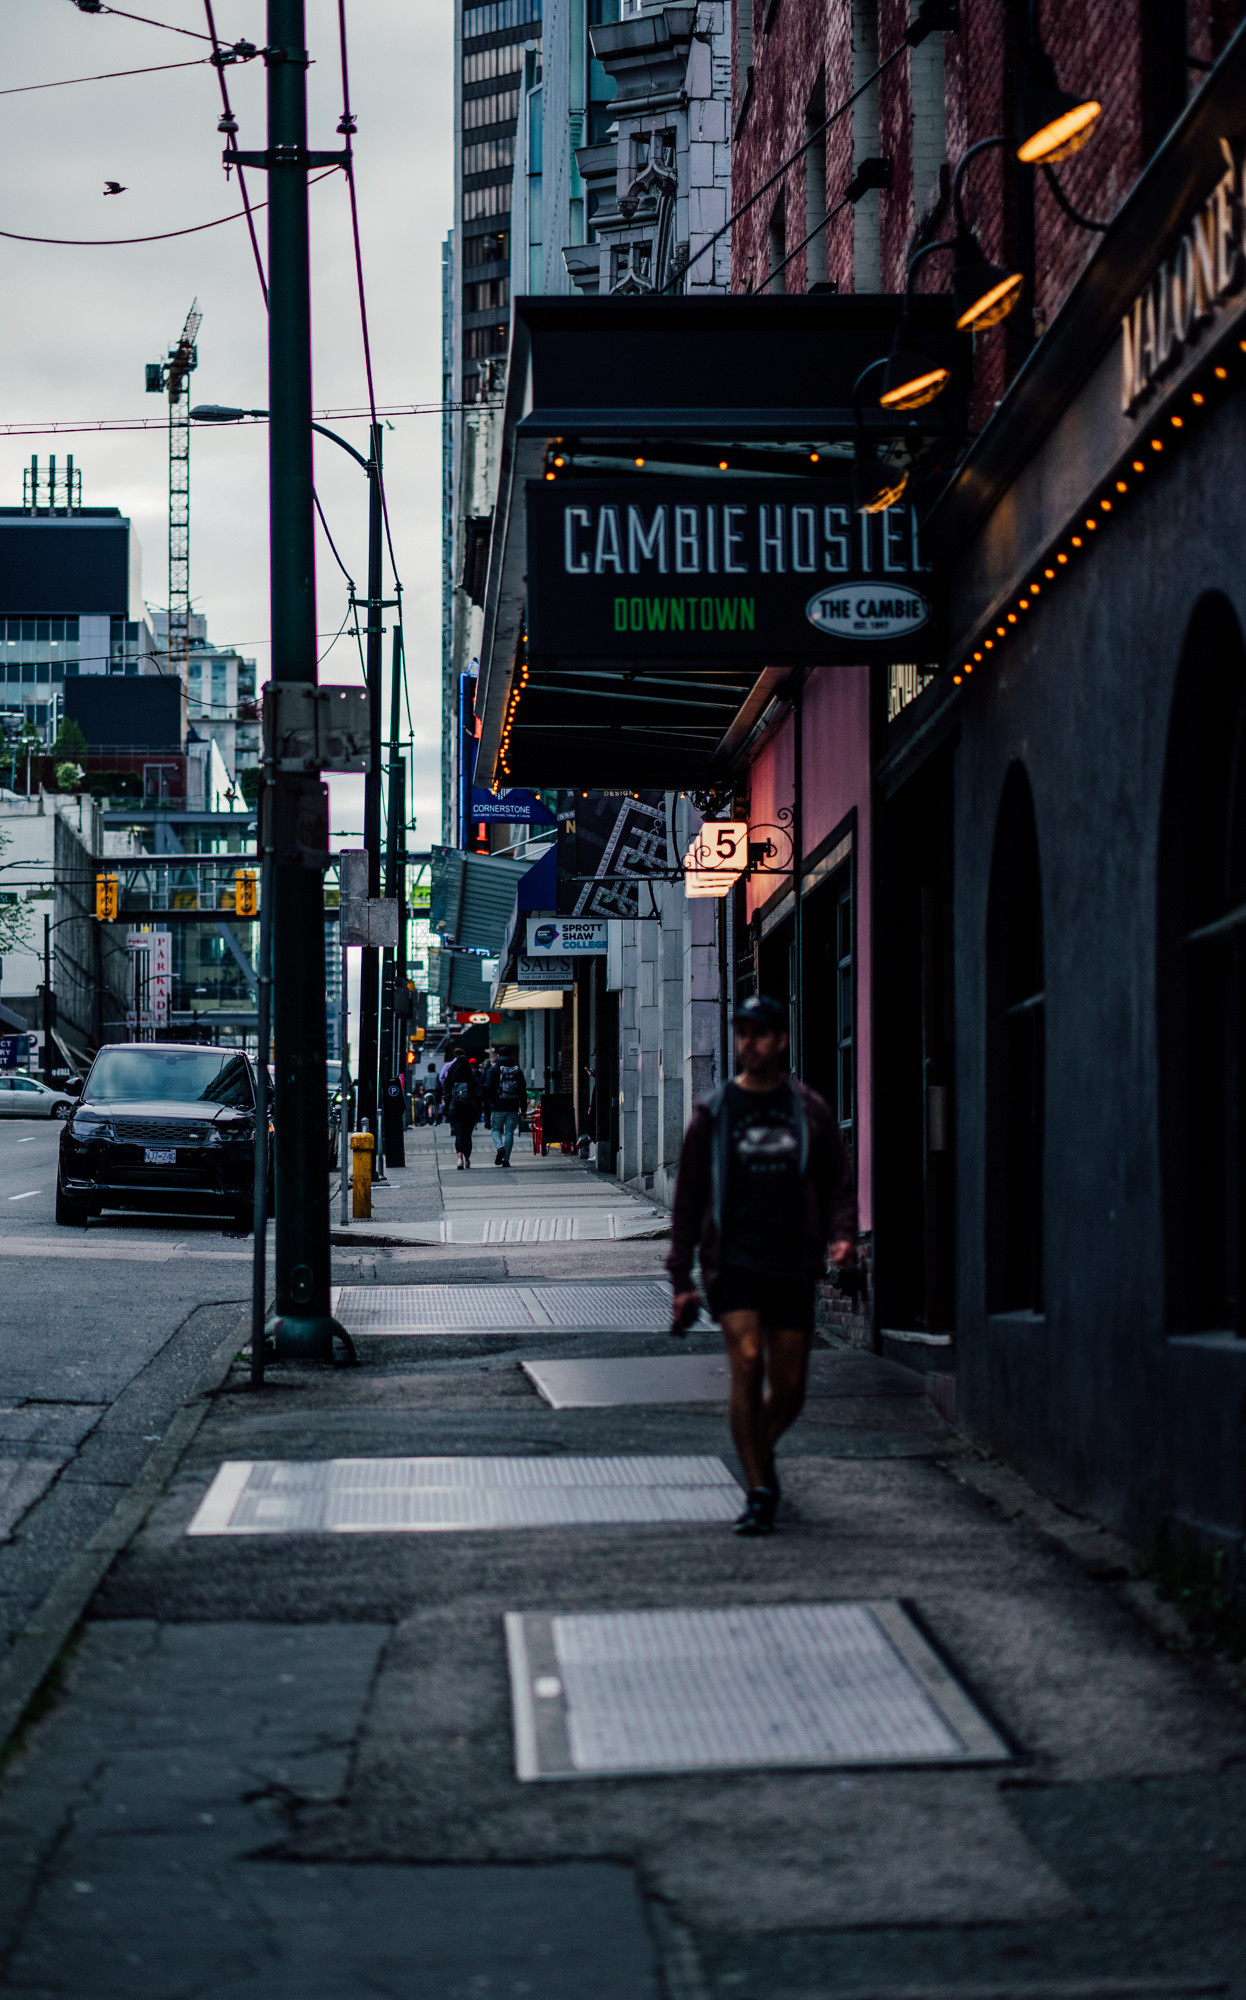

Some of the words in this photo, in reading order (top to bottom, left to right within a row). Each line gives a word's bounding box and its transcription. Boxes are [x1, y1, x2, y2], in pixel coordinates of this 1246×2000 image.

[564, 503, 749, 575] CAMBIE
[758, 503, 932, 573] HOSTEL
[613, 597, 755, 632] DOWNTOWN
[819, 598, 851, 619] THE
[855, 598, 920, 619] CAMBIE
[473, 804, 531, 814] CORNERSTONE
[716, 828, 737, 859] 5
[562, 923, 603, 932] SPROTT
[562, 932, 594, 941] SHAW
[562, 941, 608, 950] COLLEGE
[520, 955, 570, 972] SAL'S
